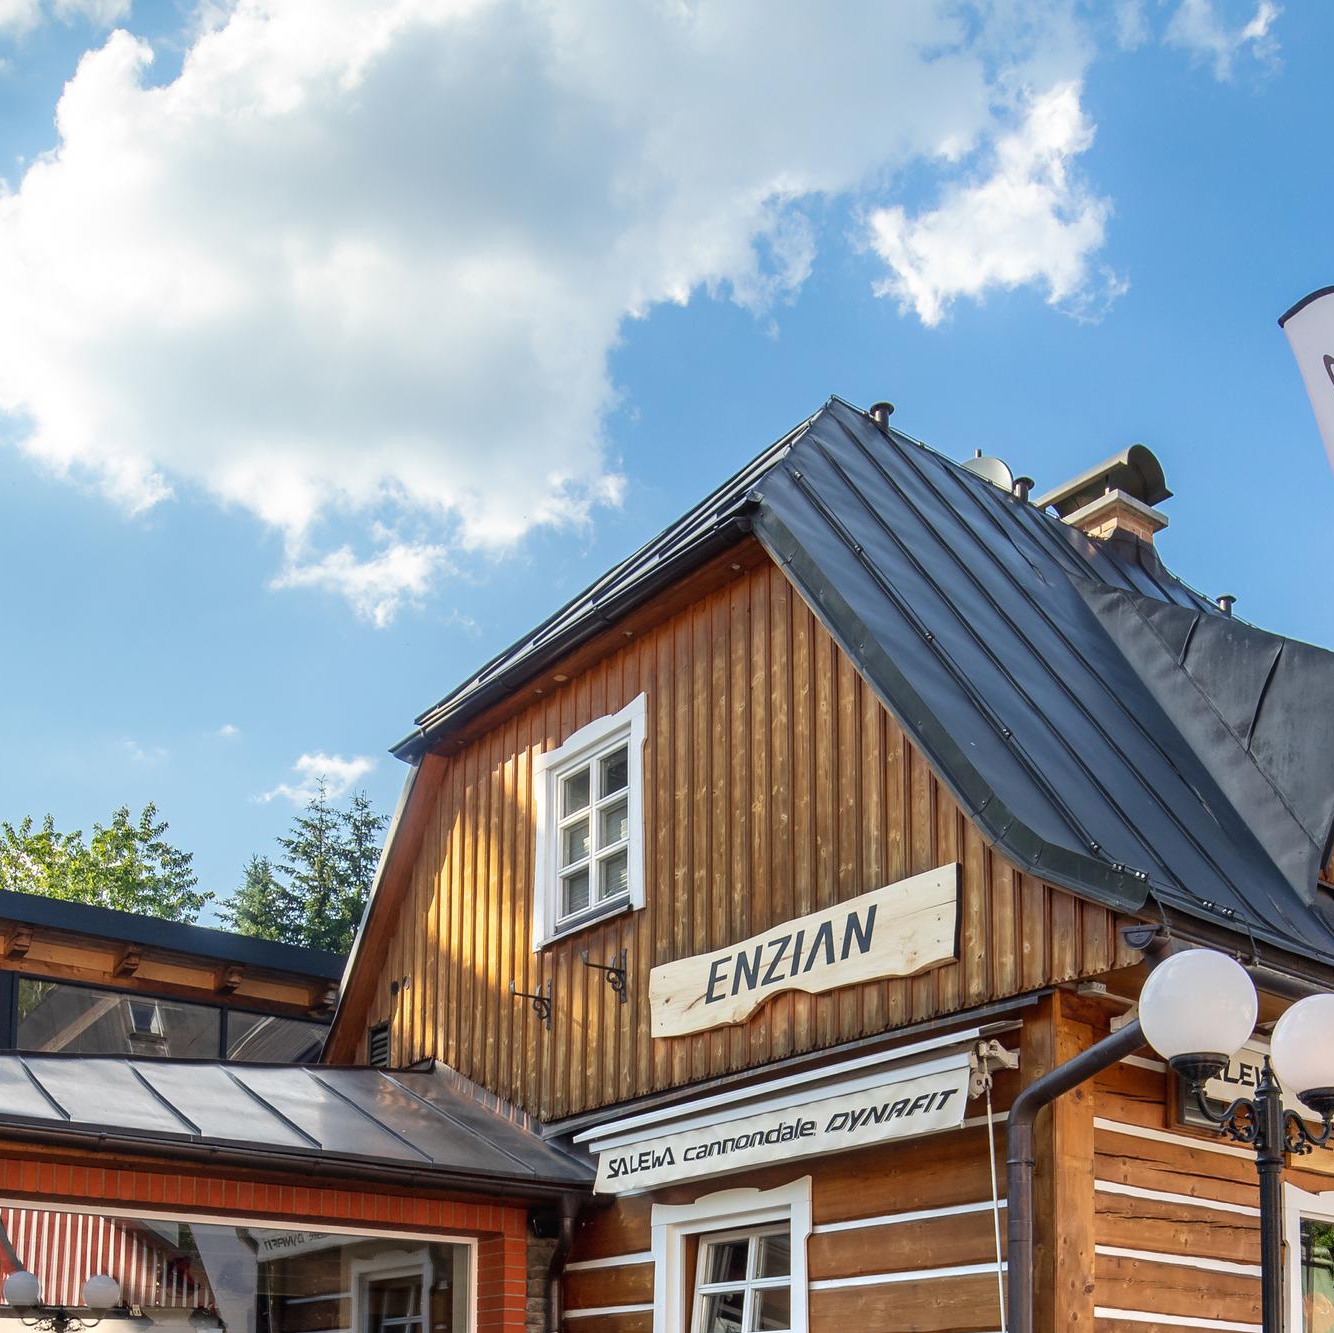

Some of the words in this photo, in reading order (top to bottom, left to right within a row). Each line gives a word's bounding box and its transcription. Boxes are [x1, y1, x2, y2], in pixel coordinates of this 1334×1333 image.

[705, 904, 878, 1004] ENZIAN
[606, 1145, 675, 1179] SALEWA
[683, 1117, 816, 1162] cannondale
[824, 1088, 959, 1133] DYNAFIT
